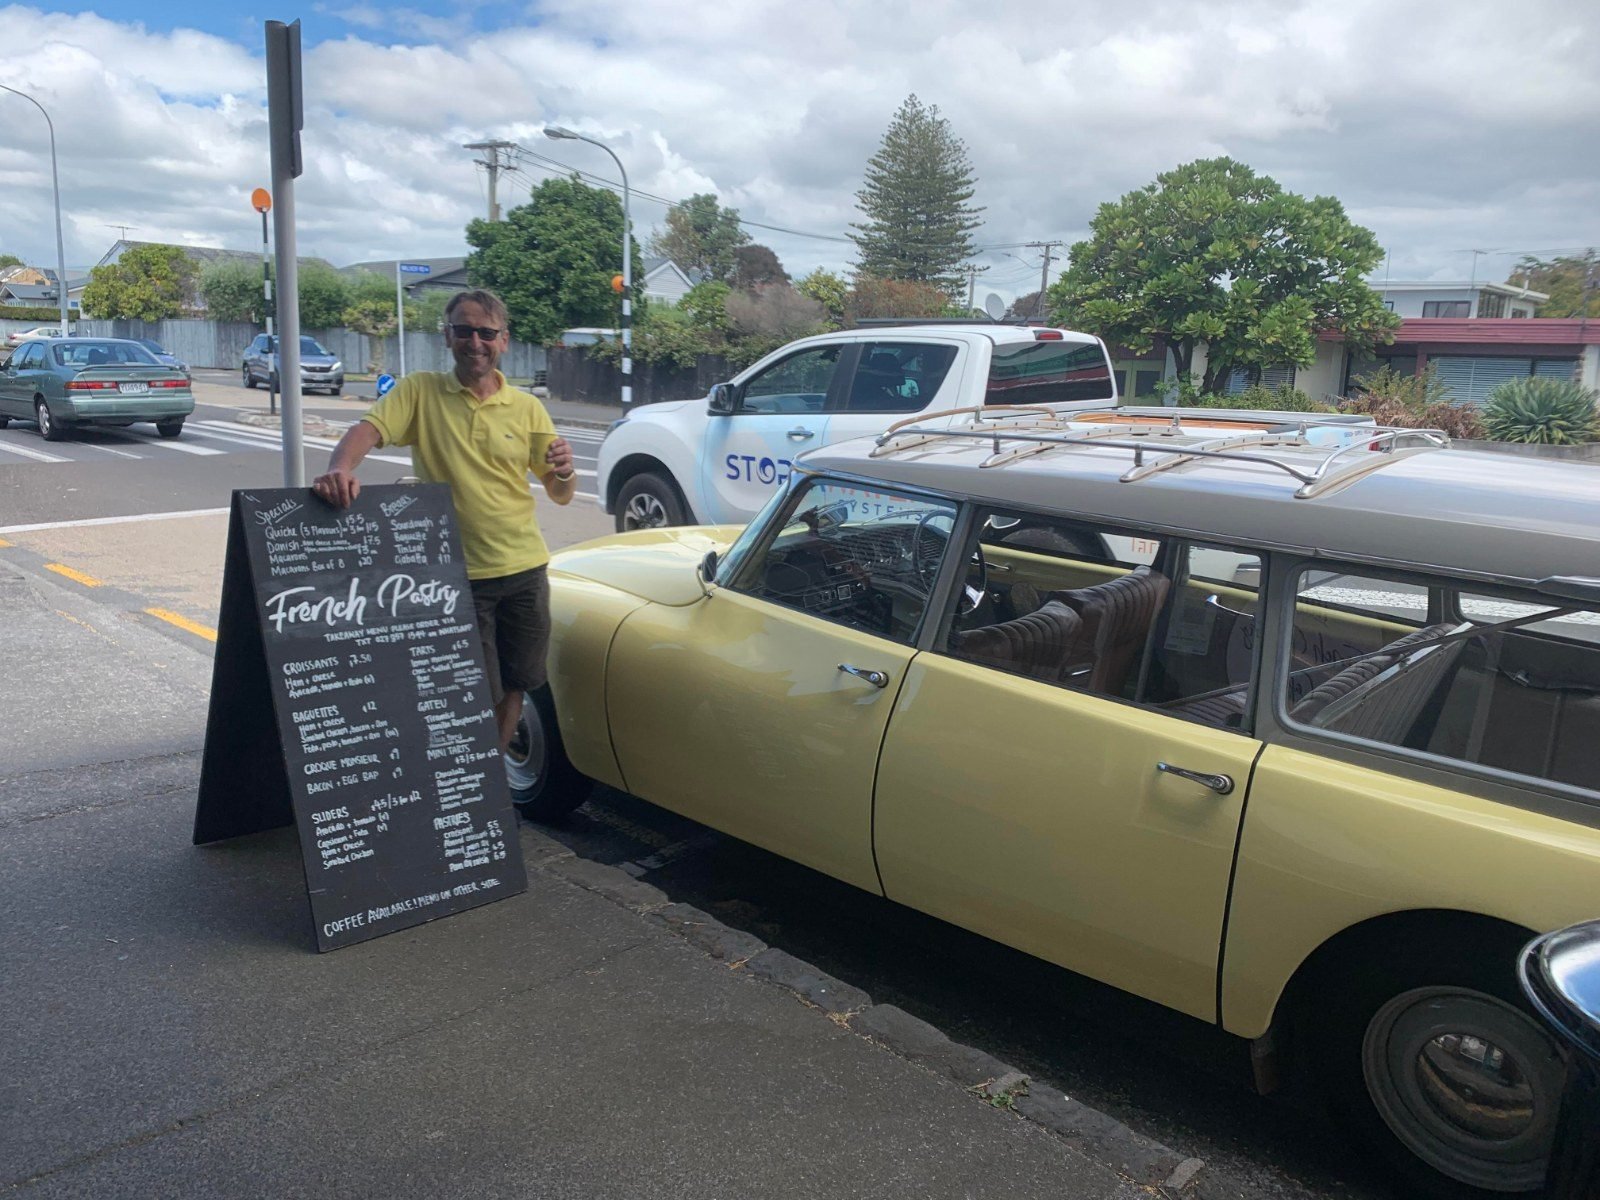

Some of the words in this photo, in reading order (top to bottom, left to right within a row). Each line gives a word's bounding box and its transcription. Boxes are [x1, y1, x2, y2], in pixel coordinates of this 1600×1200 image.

[255, 498, 298, 525] Specials
[265, 526, 298, 542] Quiche
[269, 552, 308, 565] Macarons
[271, 564, 310, 578] Macarons
[265, 576, 367, 634] French
[376, 573, 460, 617] Pastry
[323, 628, 365, 643] TAKEAWAY
[366, 625, 389, 637] MENU
[408, 644, 437, 658] TARTS
[282, 655, 340, 676] CROISSANTS
[291, 704, 340, 724] BAGUETTES
[426, 748, 448, 761] MINI
[303, 759, 338, 775] CROQUE
[306, 779, 334, 795] BACON
[341, 773, 359, 786] EGG
[310, 806, 350, 824] SLIDERS
[433, 811, 472, 831] PASTRIES
[323, 911, 366, 938] COFFEE
[417, 892, 441, 908] MENU
[452, 882, 480, 898] OTHER
